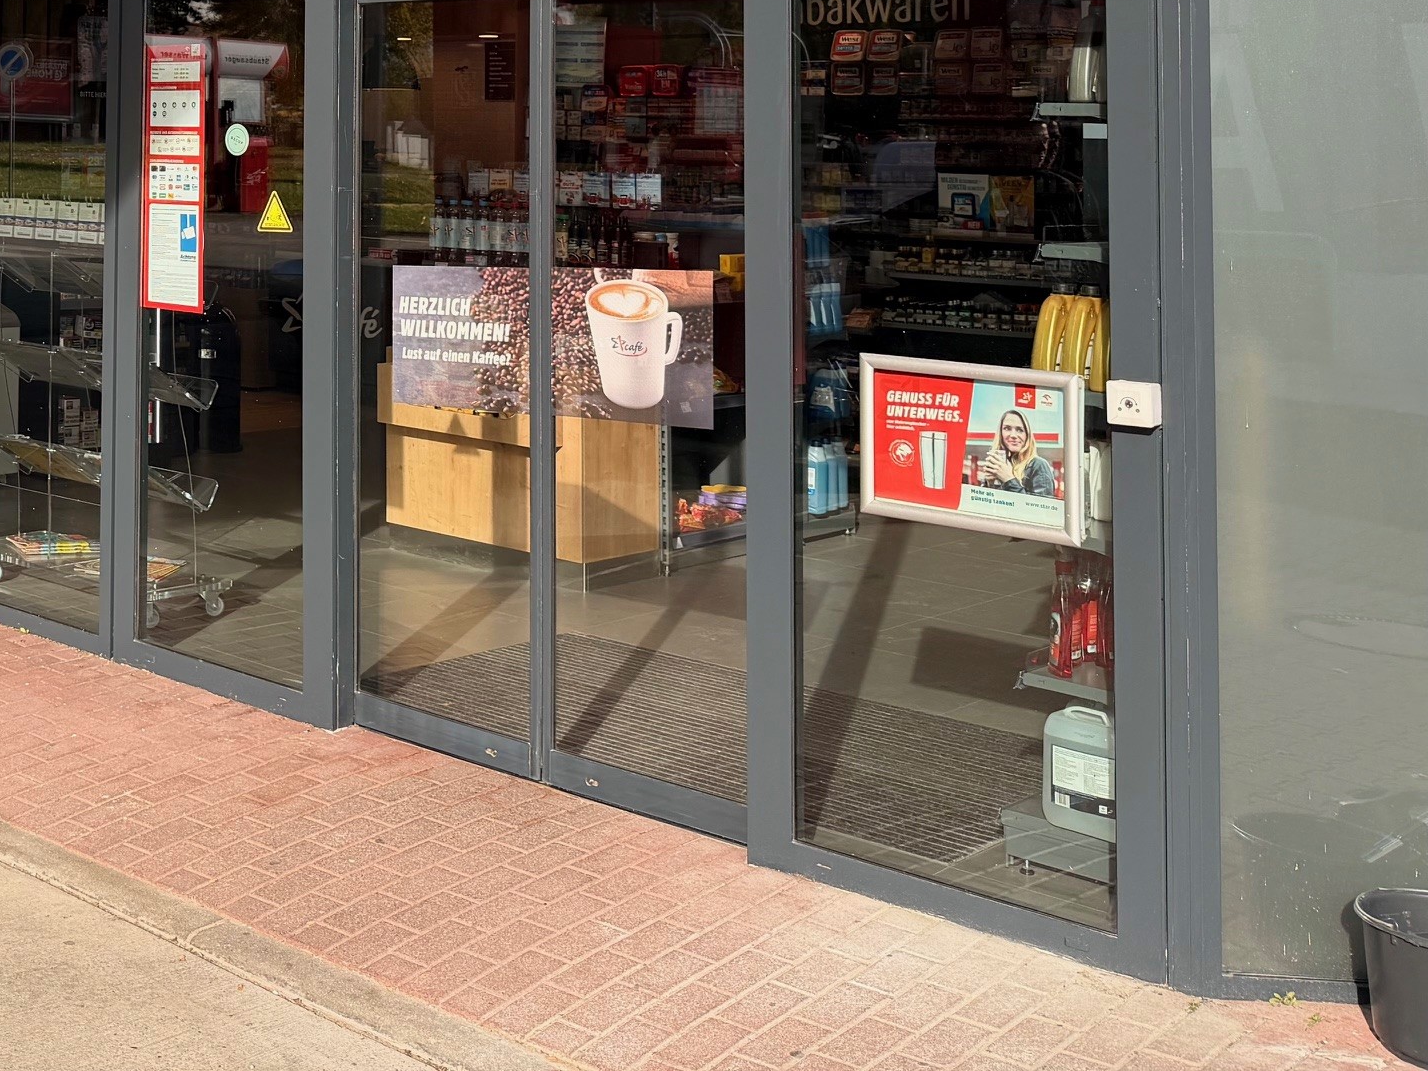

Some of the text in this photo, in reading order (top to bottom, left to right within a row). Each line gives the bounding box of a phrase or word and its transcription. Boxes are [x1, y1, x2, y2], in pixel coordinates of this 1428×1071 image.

[399, 296, 472, 317] HERZLICH
[359, 306, 383, 339] fé
[400, 319, 511, 342] WILLKOMMEN!
[402, 347, 512, 366] Lust auf einen Kaffee?
[886, 390, 959, 407] GENUSS FÜR
[886, 405, 964, 423] UNTERWEGS.
